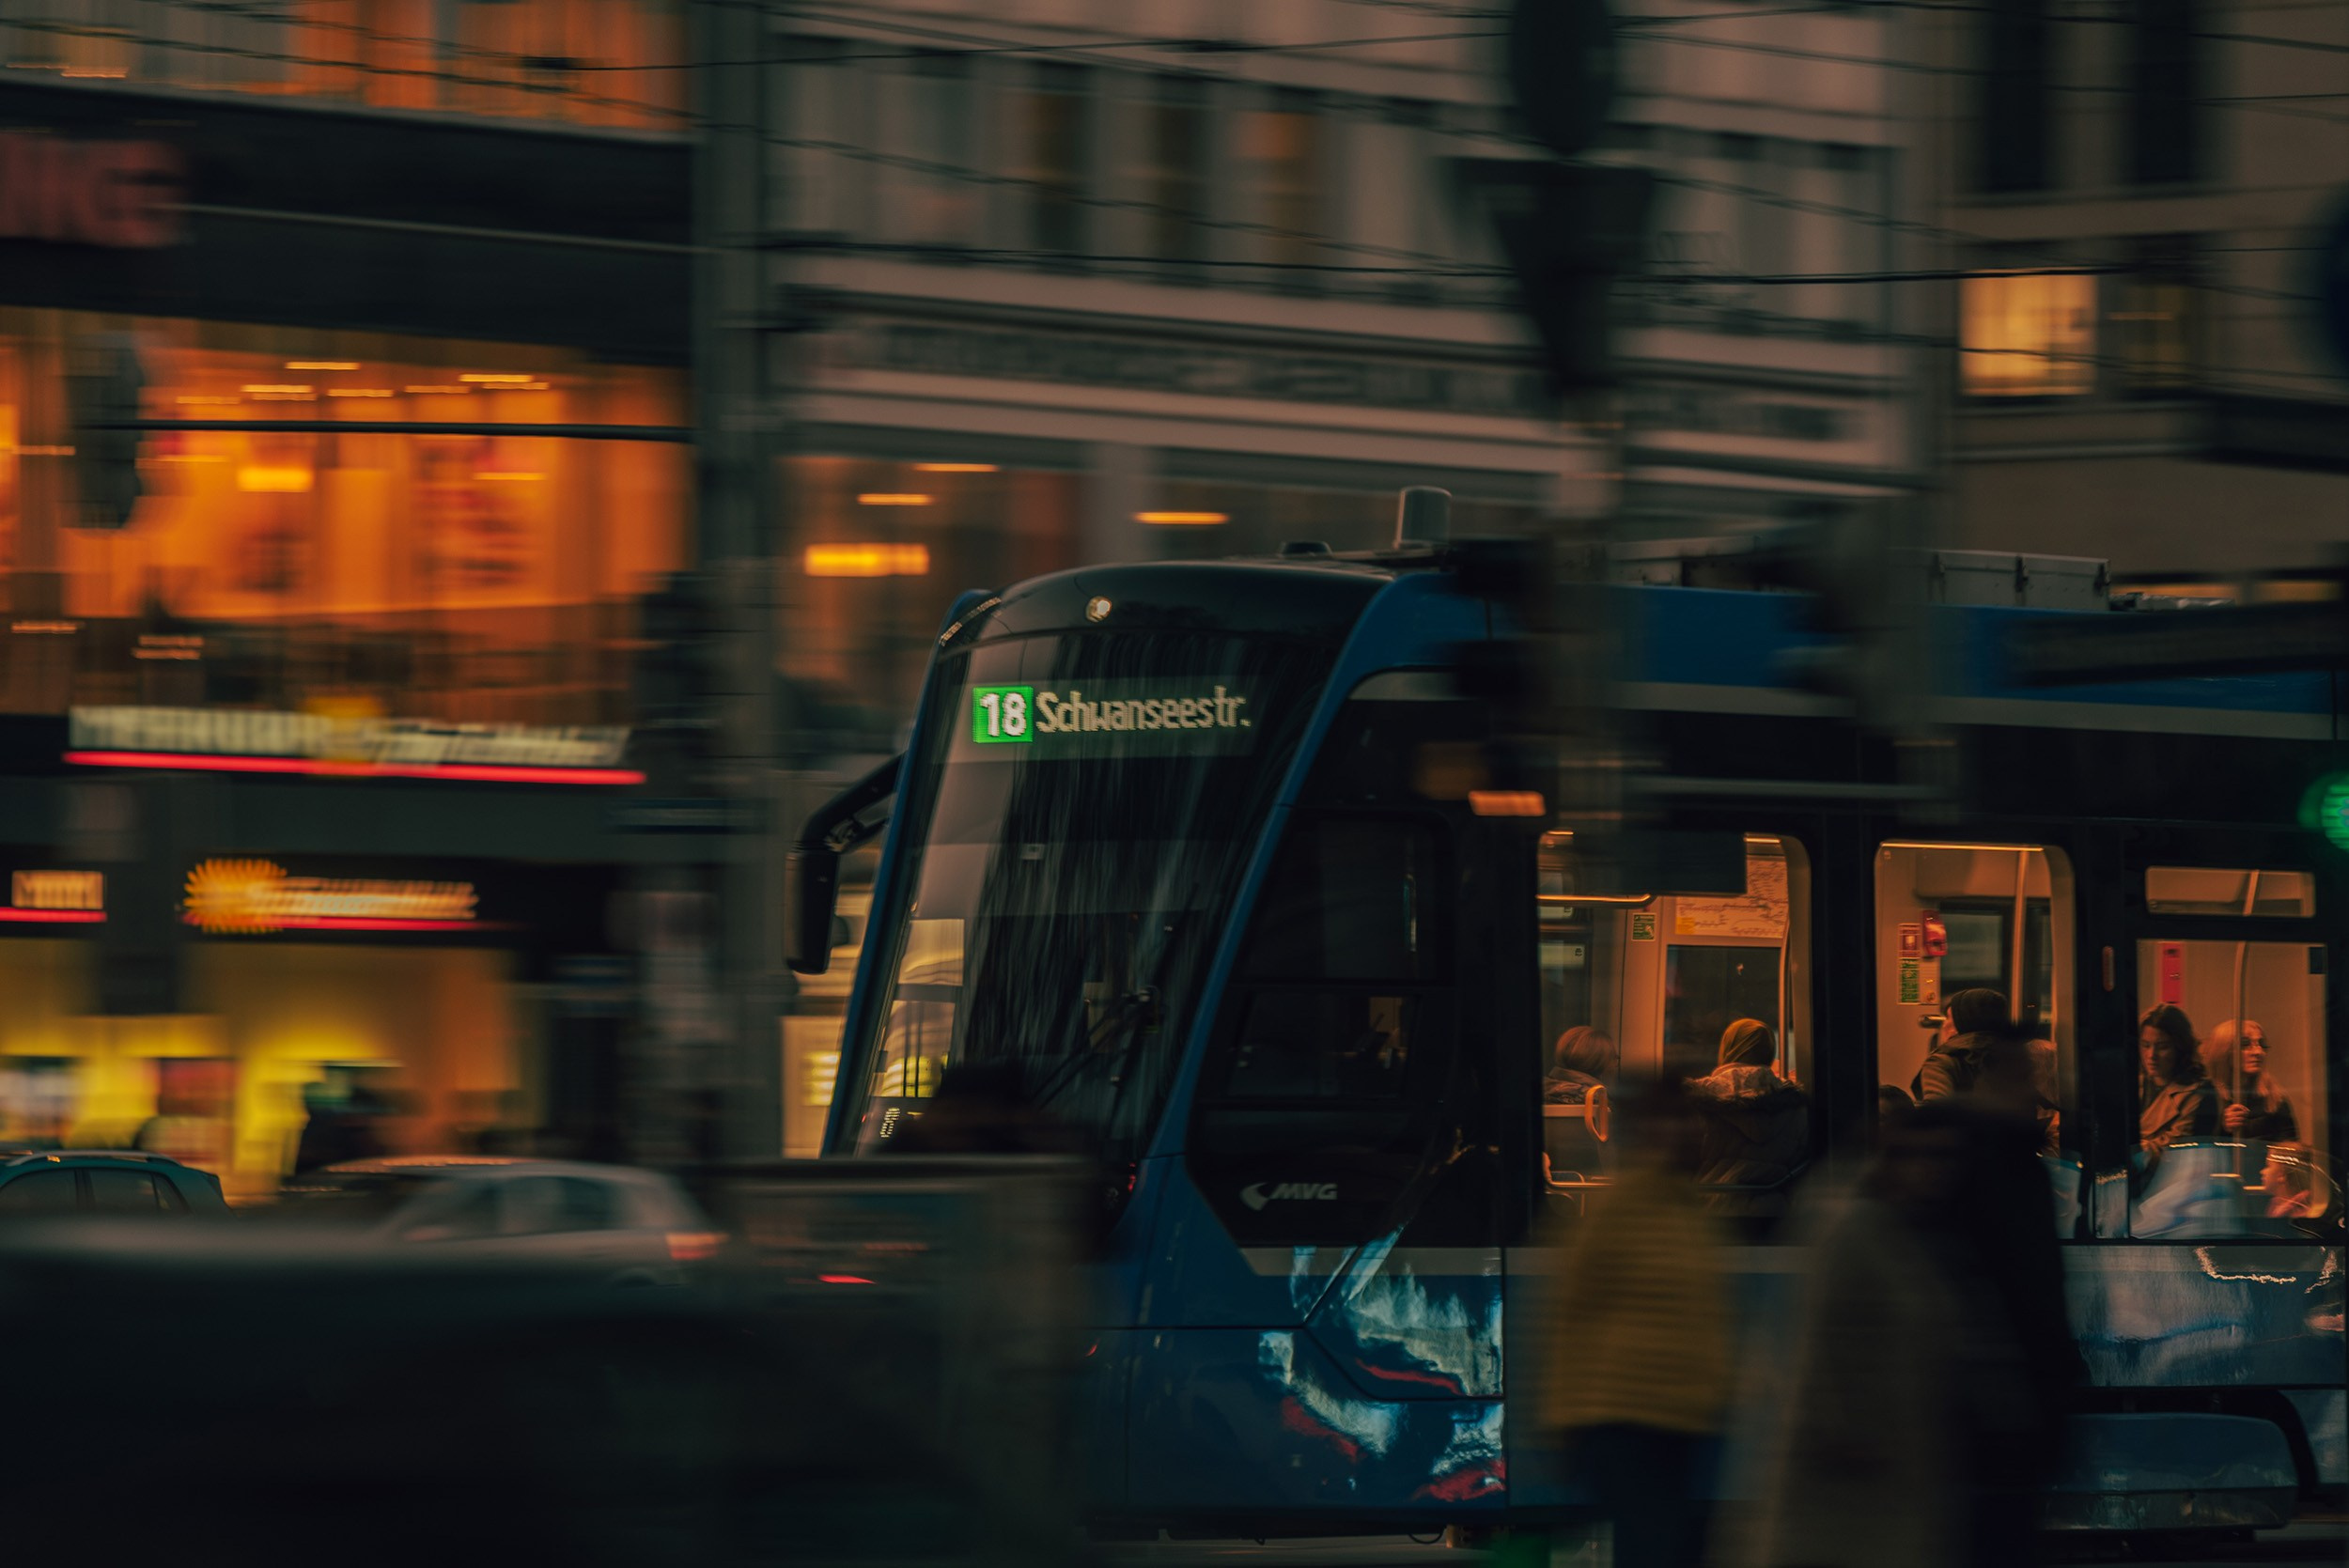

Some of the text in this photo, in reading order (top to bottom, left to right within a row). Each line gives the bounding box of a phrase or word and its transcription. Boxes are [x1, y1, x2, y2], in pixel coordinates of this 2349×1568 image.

[980, 686, 1251, 737] 18 Schwanseestr.
[1269, 1183, 1338, 1201] MVG
